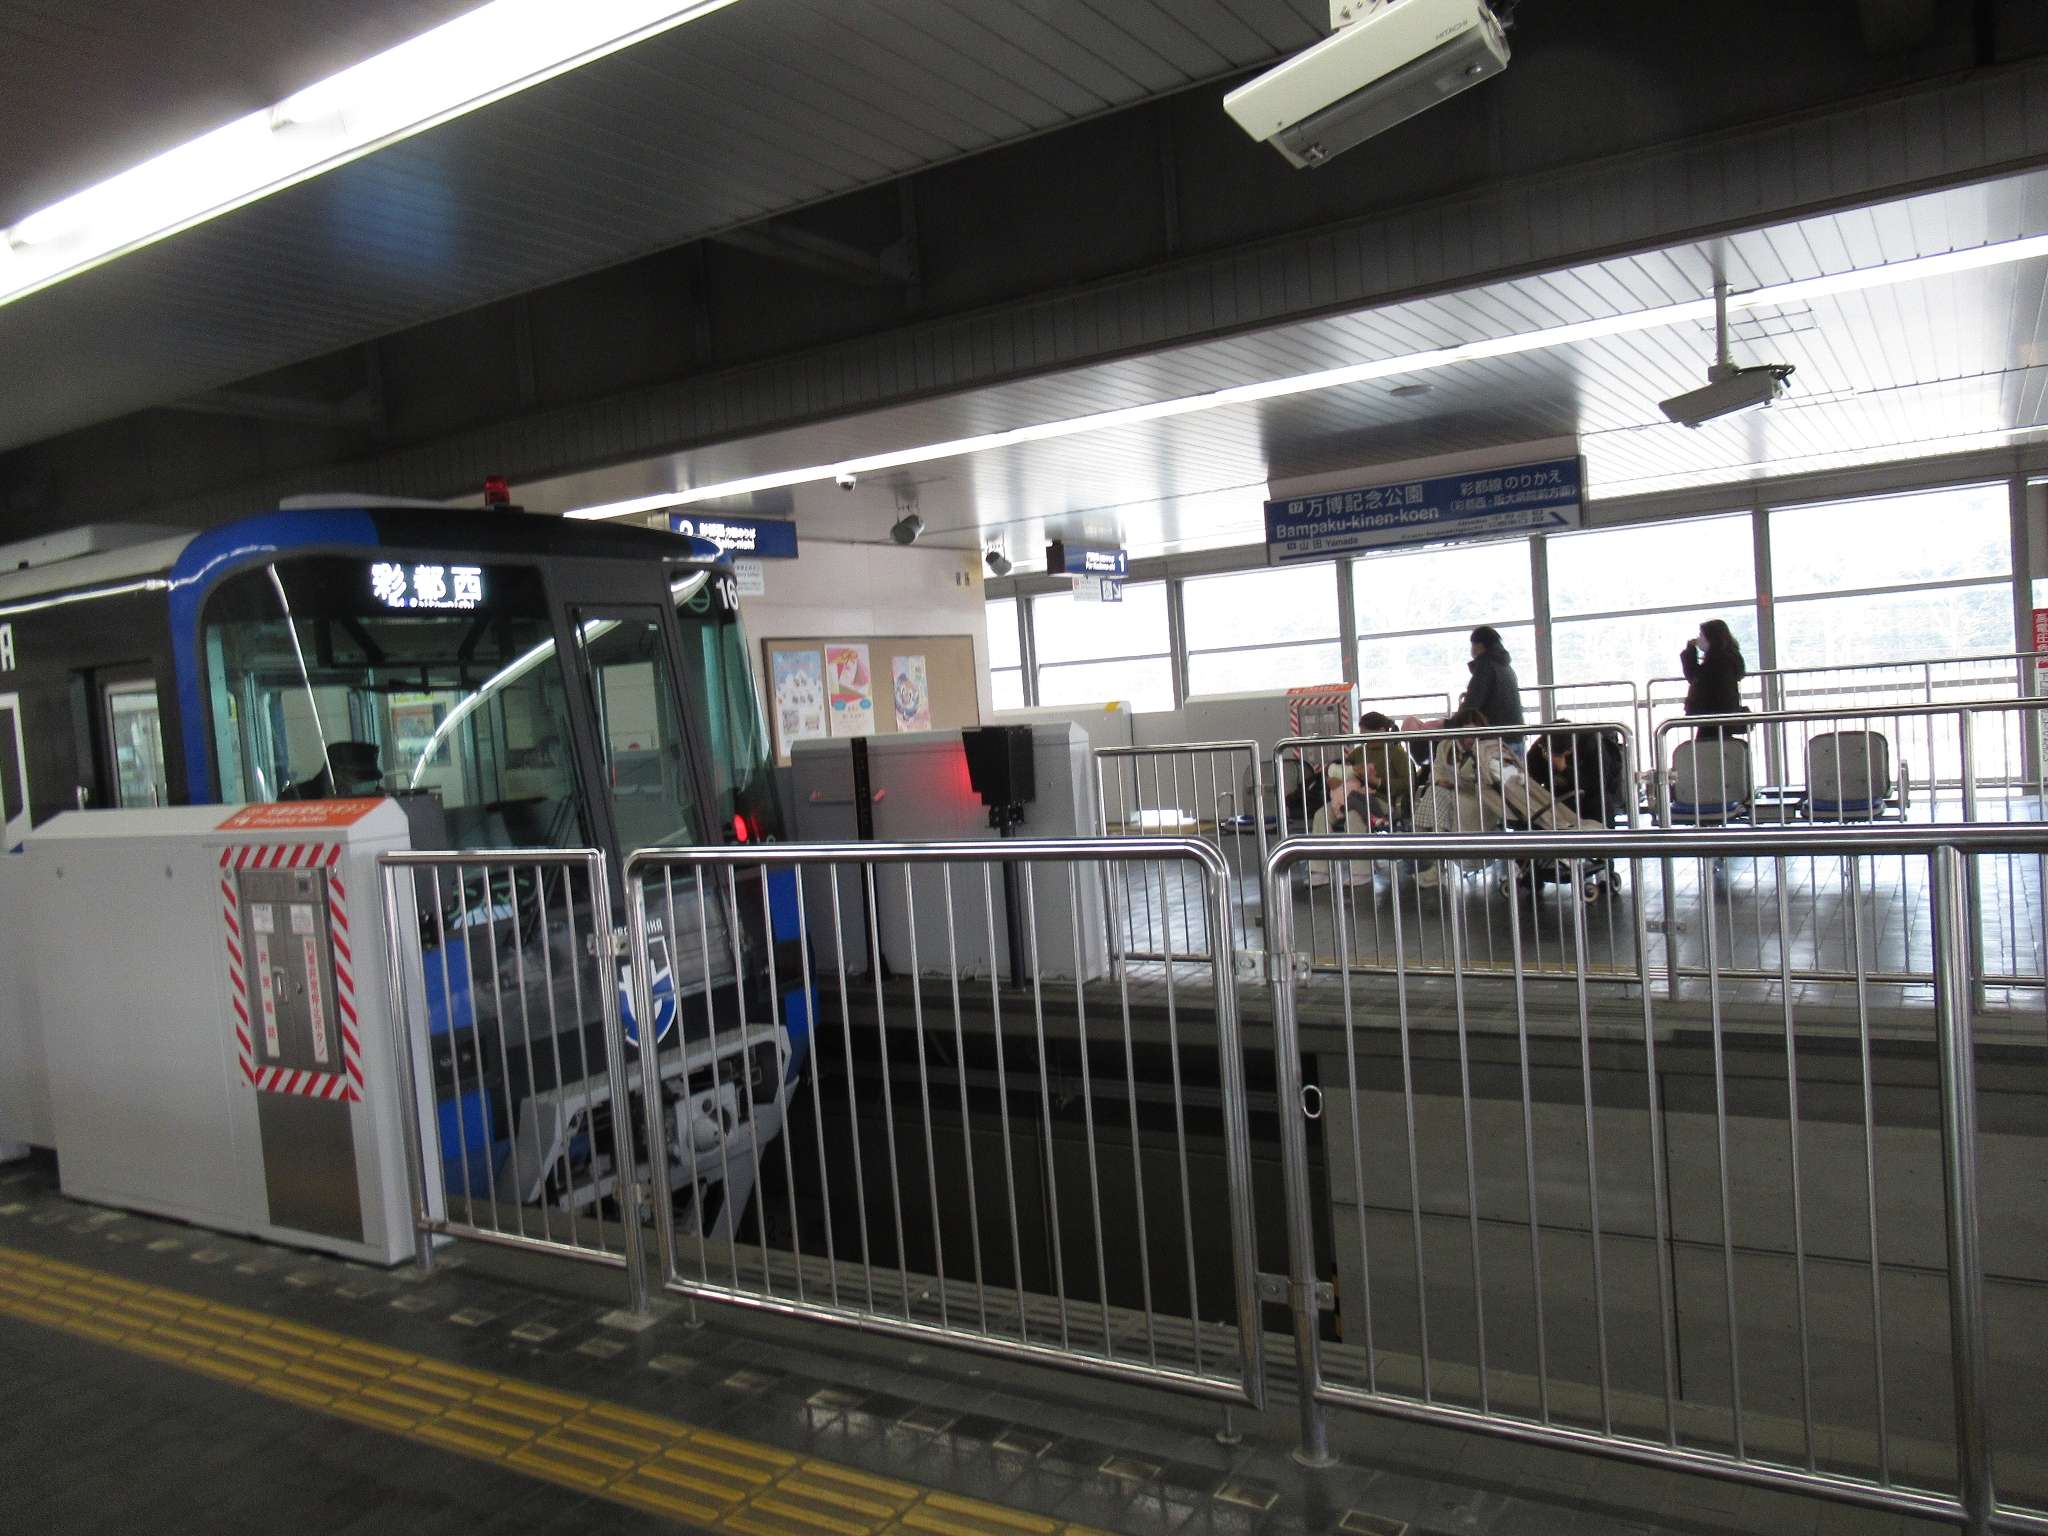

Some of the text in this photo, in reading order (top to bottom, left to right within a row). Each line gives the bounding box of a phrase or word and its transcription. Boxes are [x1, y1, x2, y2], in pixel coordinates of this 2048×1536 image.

[1435, 19, 1468, 41] HITACHI
[1307, 484, 1424, 517] 万博記念公園
[1276, 507, 1440, 540] Bampaku-kinen-koen
[1326, 537, 1359, 548] Yamada
[371, 562, 482, 602] 彩都西
[715, 577, 739, 611] 16
